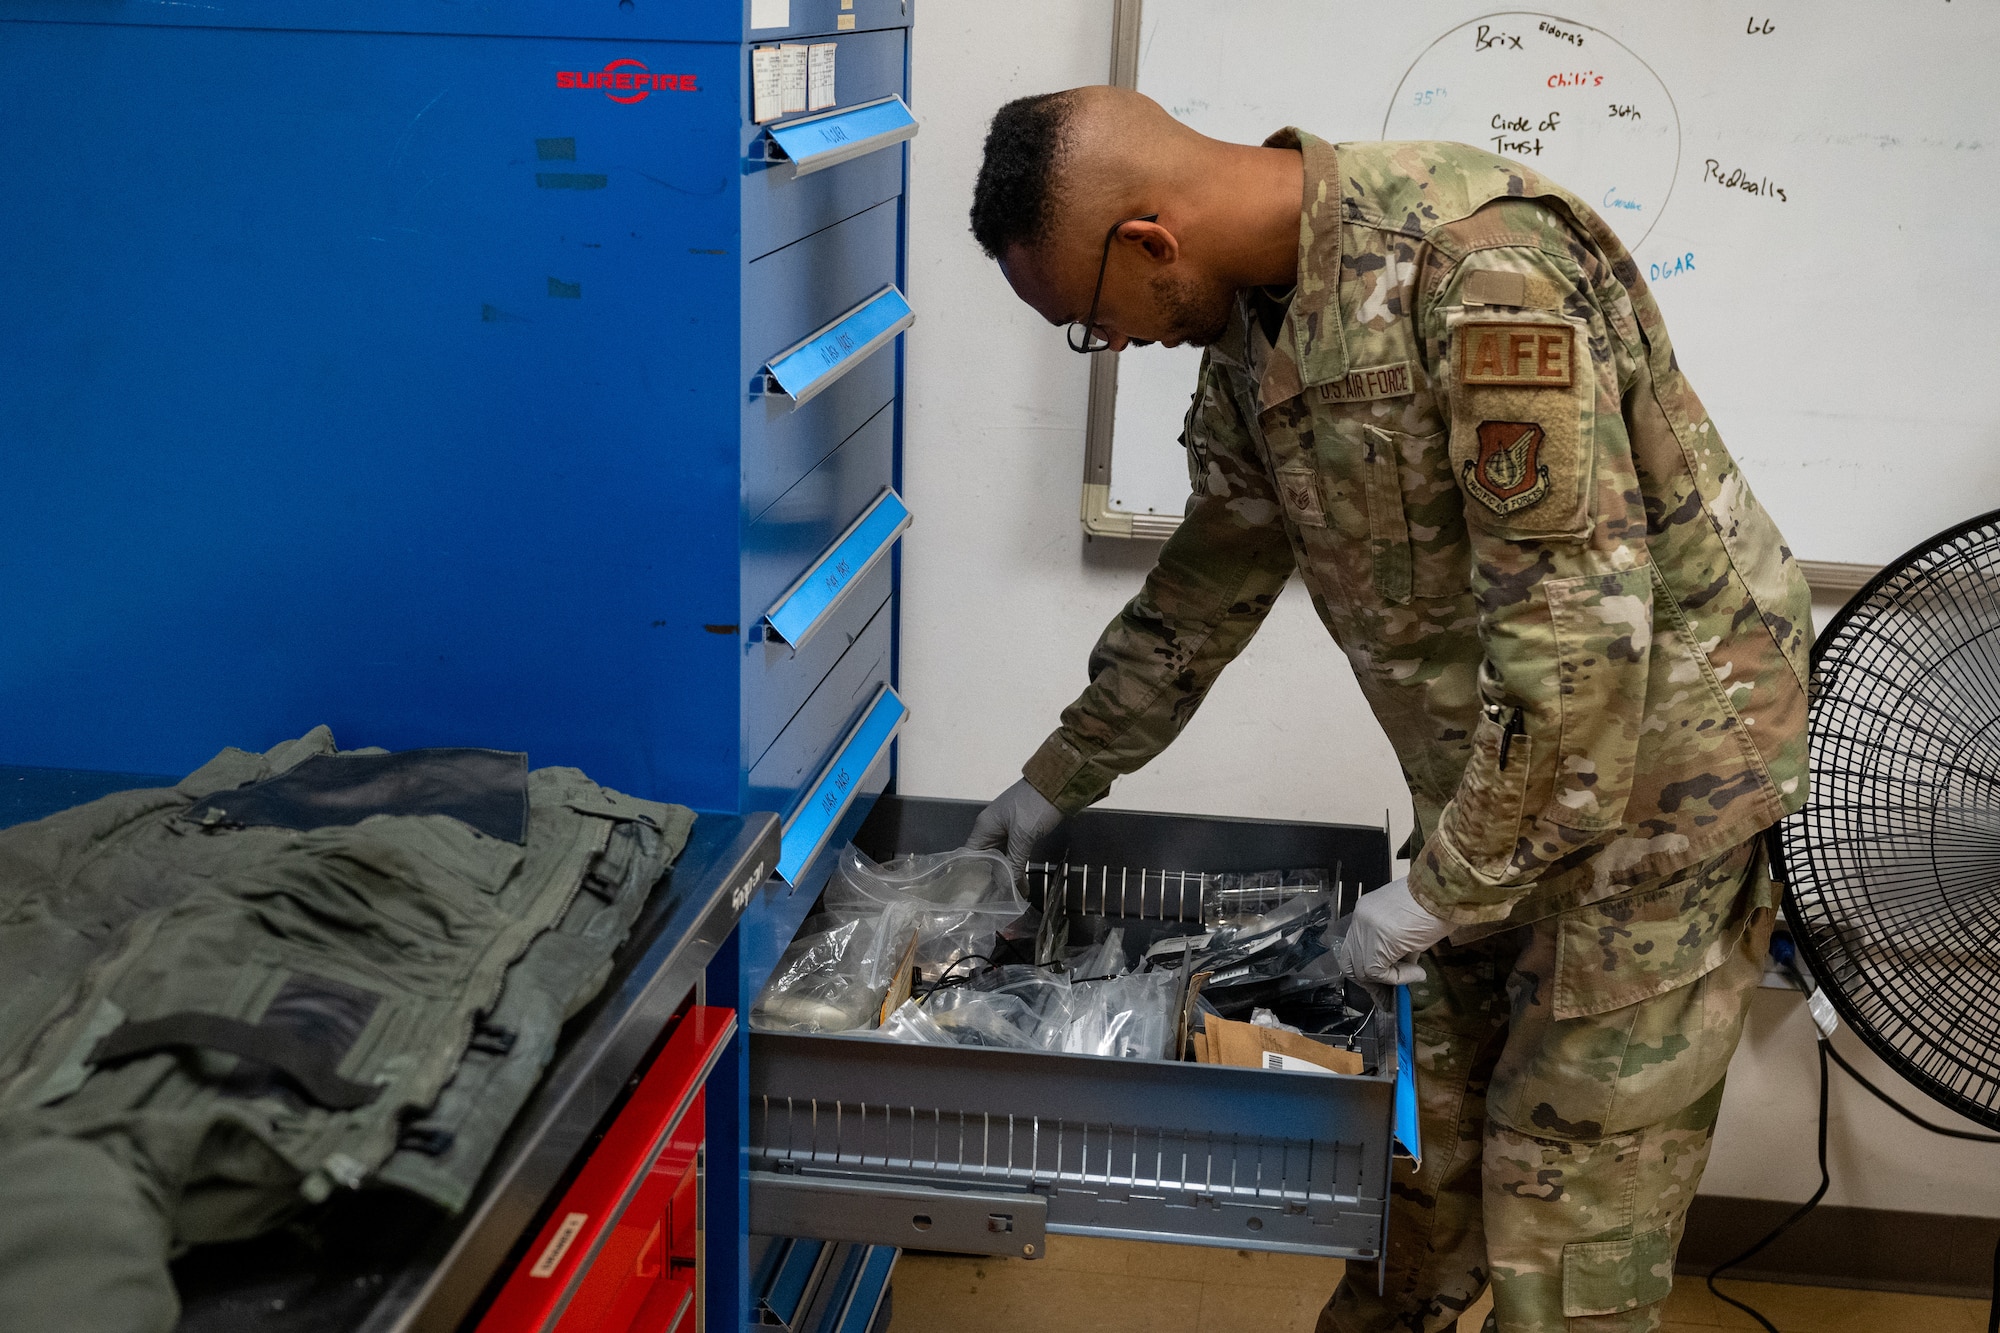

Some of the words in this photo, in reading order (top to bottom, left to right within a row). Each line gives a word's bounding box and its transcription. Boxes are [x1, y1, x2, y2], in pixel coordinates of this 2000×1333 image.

[1475, 25, 1524, 52] Brix
[1539, 21, 1584, 47] Eldora's
[556, 71, 698, 91] SUREFIRE
[1547, 70, 1604, 88] Chili's
[1538, 111, 1561, 132] of
[1608, 104, 1642, 121] 36th
[1490, 135, 1544, 156] Trust
[1703, 158, 1788, 203] Redballs
[1650, 252, 1696, 282] DGAR
[1470, 332, 1563, 377] AFE
[1319, 382, 1345, 400] U.S.
[1345, 373, 1366, 399] AIR
[1365, 366, 1408, 397] FORCE
[1468, 481, 1496, 505] PACIFIC
[1495, 502, 1509, 513] AIR
[1511, 486, 1544, 509] FORCES
